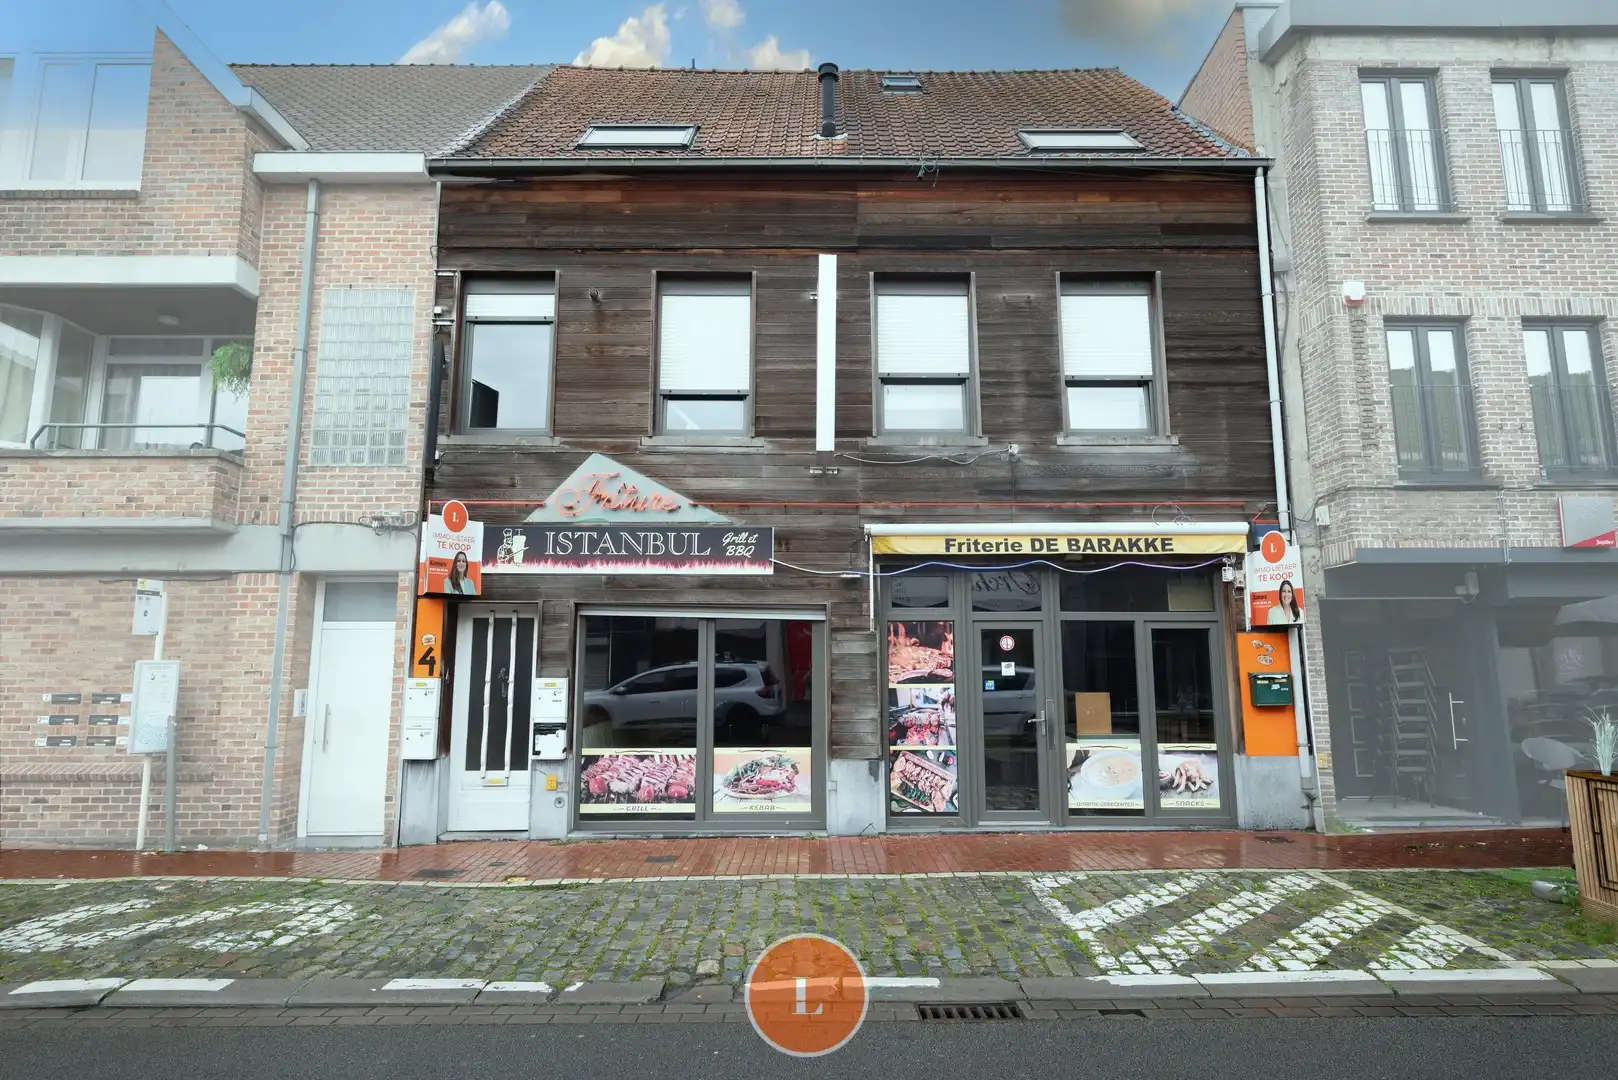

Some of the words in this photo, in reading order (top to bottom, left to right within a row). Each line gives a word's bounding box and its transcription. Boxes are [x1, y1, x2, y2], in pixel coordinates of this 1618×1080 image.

[544, 531, 712, 556] ISTANBUL
[722, 531, 748, 546] Grill
[944, 538, 1023, 552] Friterie
[1030, 538, 1059, 552] DE
[1066, 538, 1174, 552] BARAKKE
[437, 541, 447, 549] TE
[449, 542, 471, 552] KOOP
[726, 545, 755, 558] BBQ
[1258, 574, 1268, 582] TE
[1270, 571, 1294, 581] KOOP
[418, 646, 437, 677] 4
